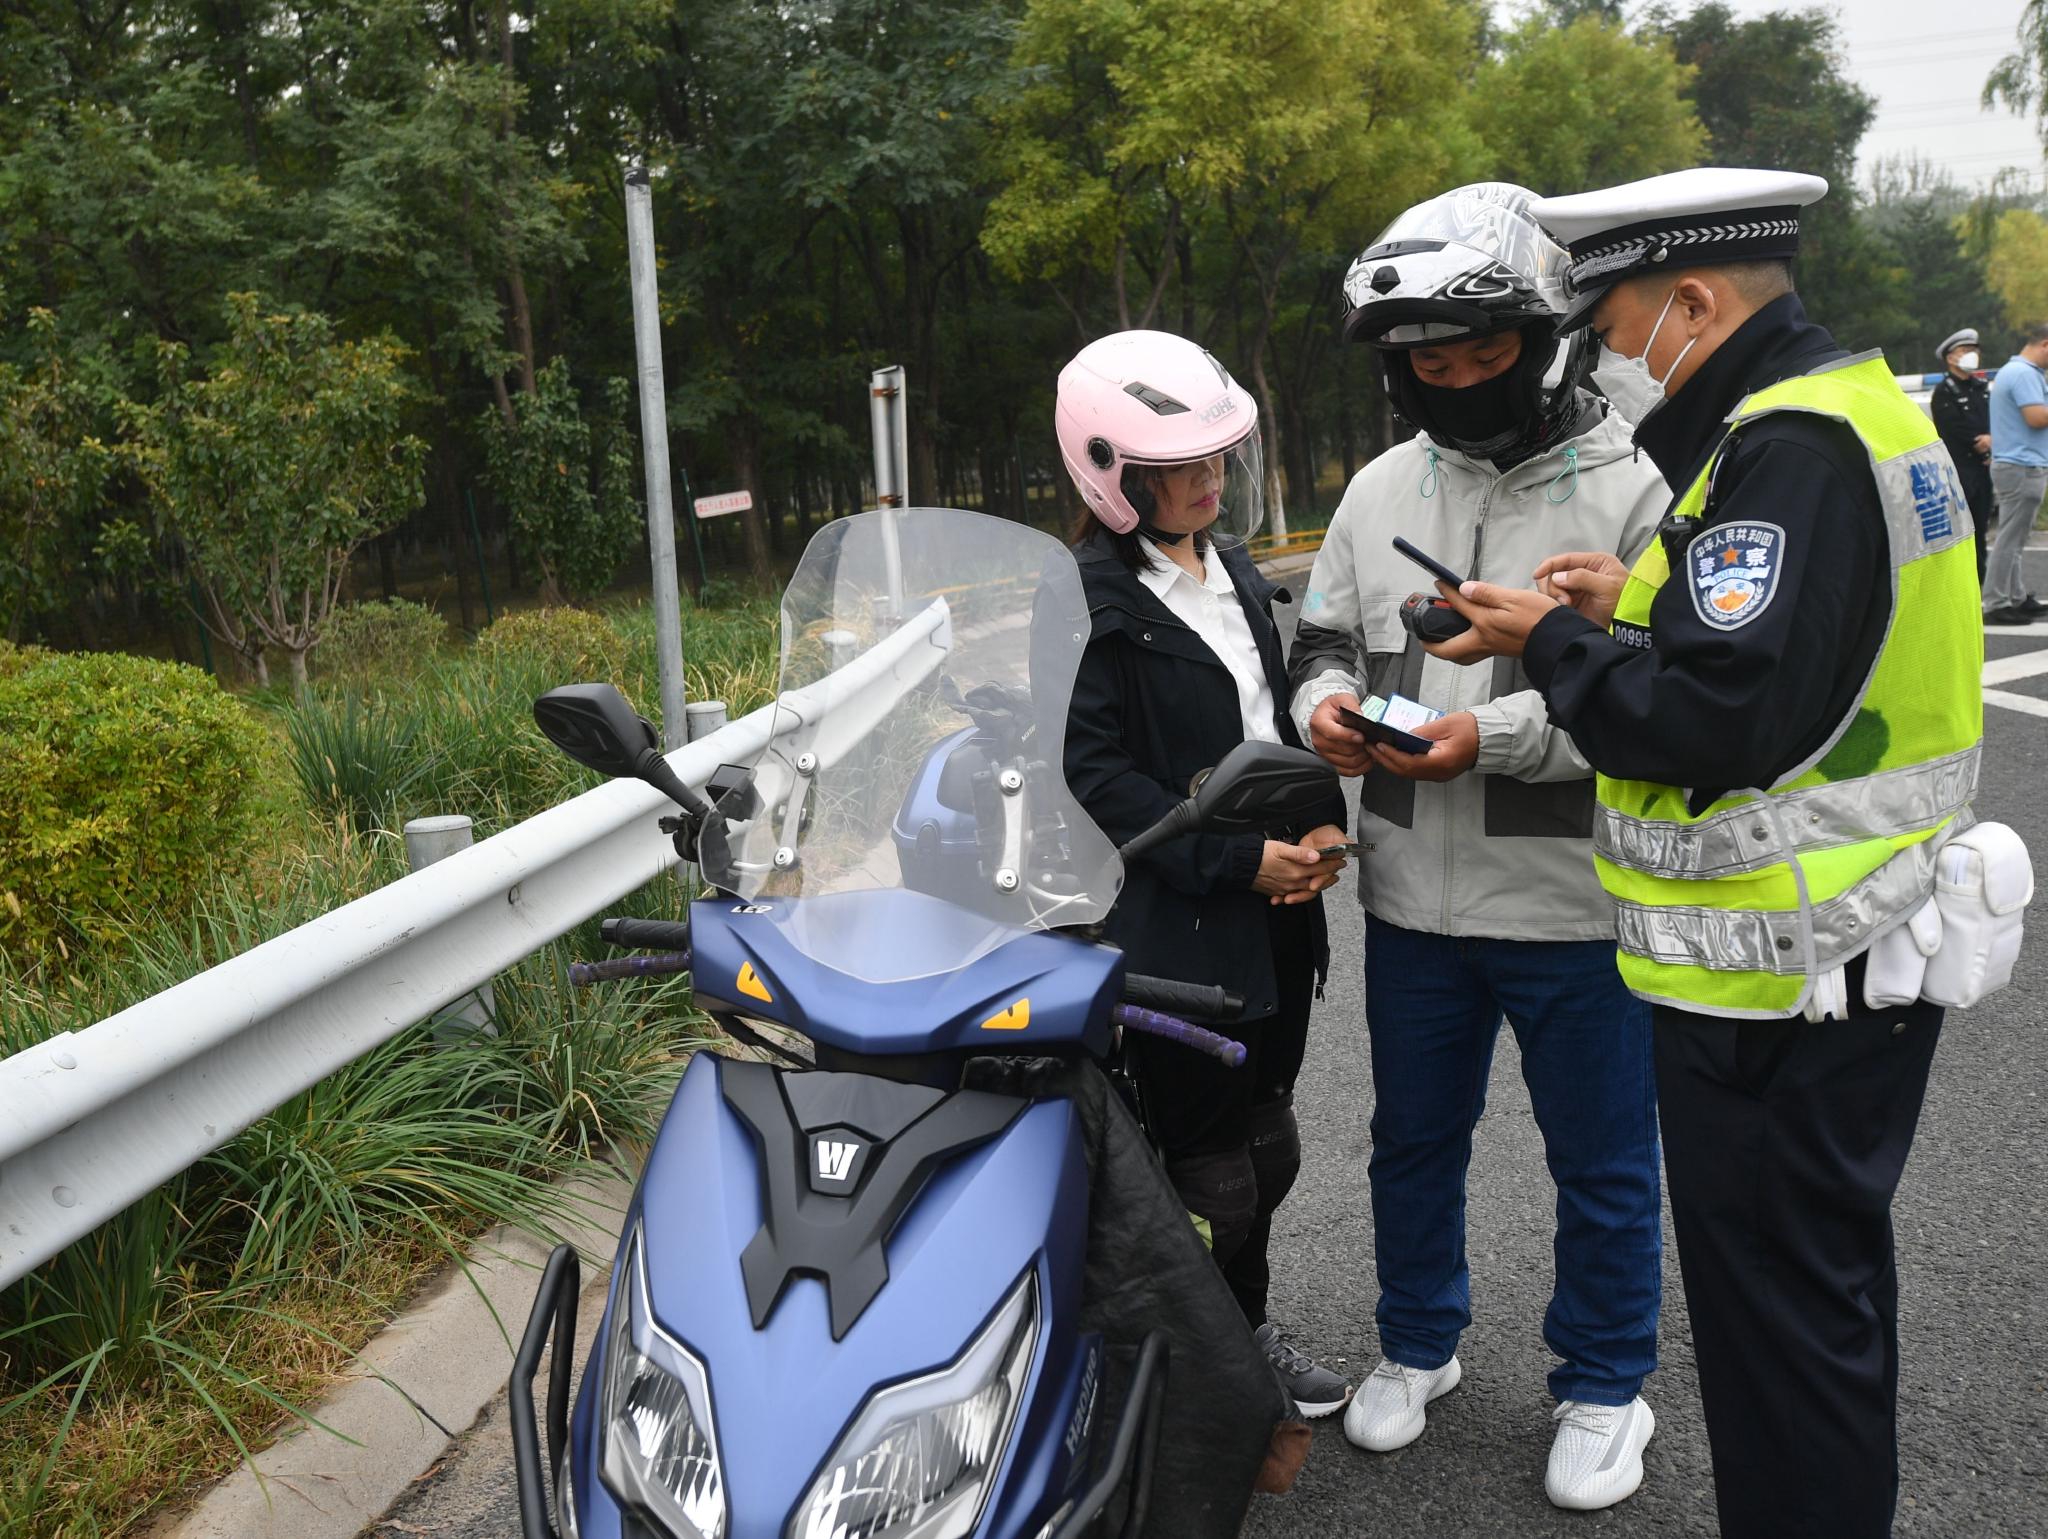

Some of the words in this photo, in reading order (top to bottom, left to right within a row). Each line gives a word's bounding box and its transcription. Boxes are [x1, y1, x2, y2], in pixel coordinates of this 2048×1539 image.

[1695, 528, 1774, 558] 中华人民共和国
[1699, 547, 1767, 576] 警察
[1713, 569, 1749, 582] POLICE
[1615, 625, 1652, 649] 00995
